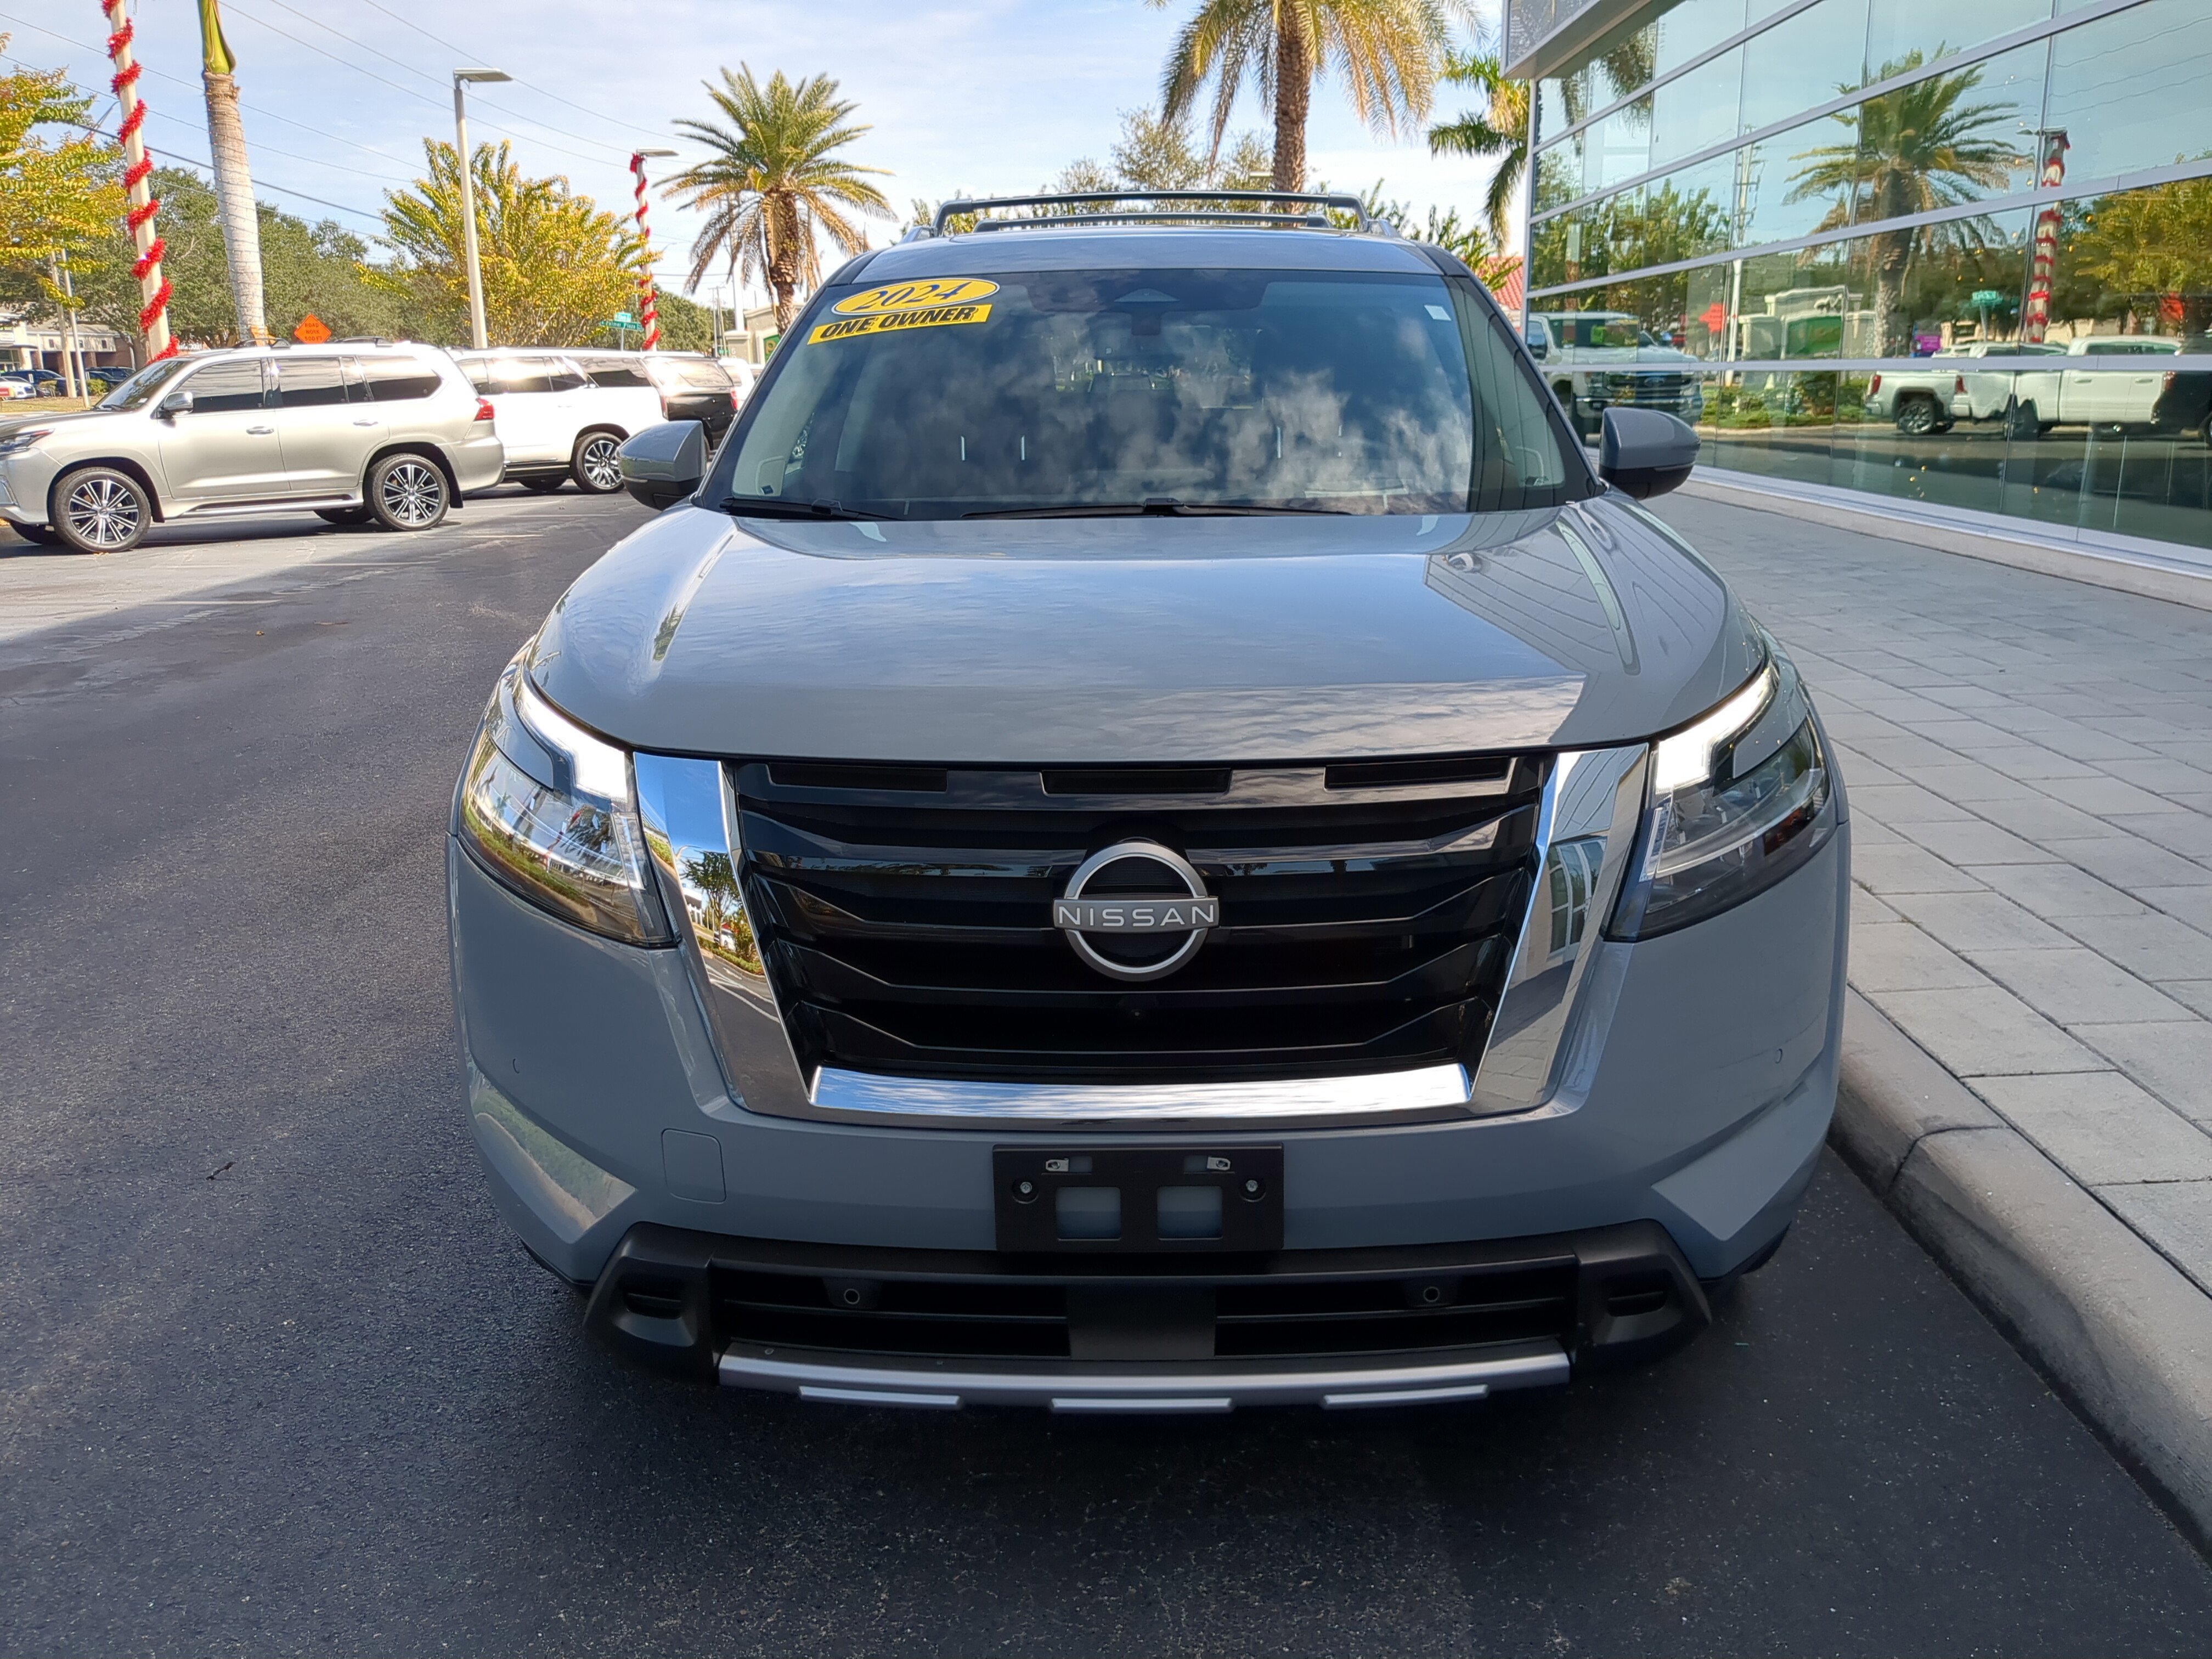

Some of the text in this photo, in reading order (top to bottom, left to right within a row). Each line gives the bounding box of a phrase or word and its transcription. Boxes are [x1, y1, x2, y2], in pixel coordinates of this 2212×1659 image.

[850, 281, 973, 312] 2024
[820, 306, 979, 339] ONE OWNER
[1058, 904, 1214, 927] NISSAN
